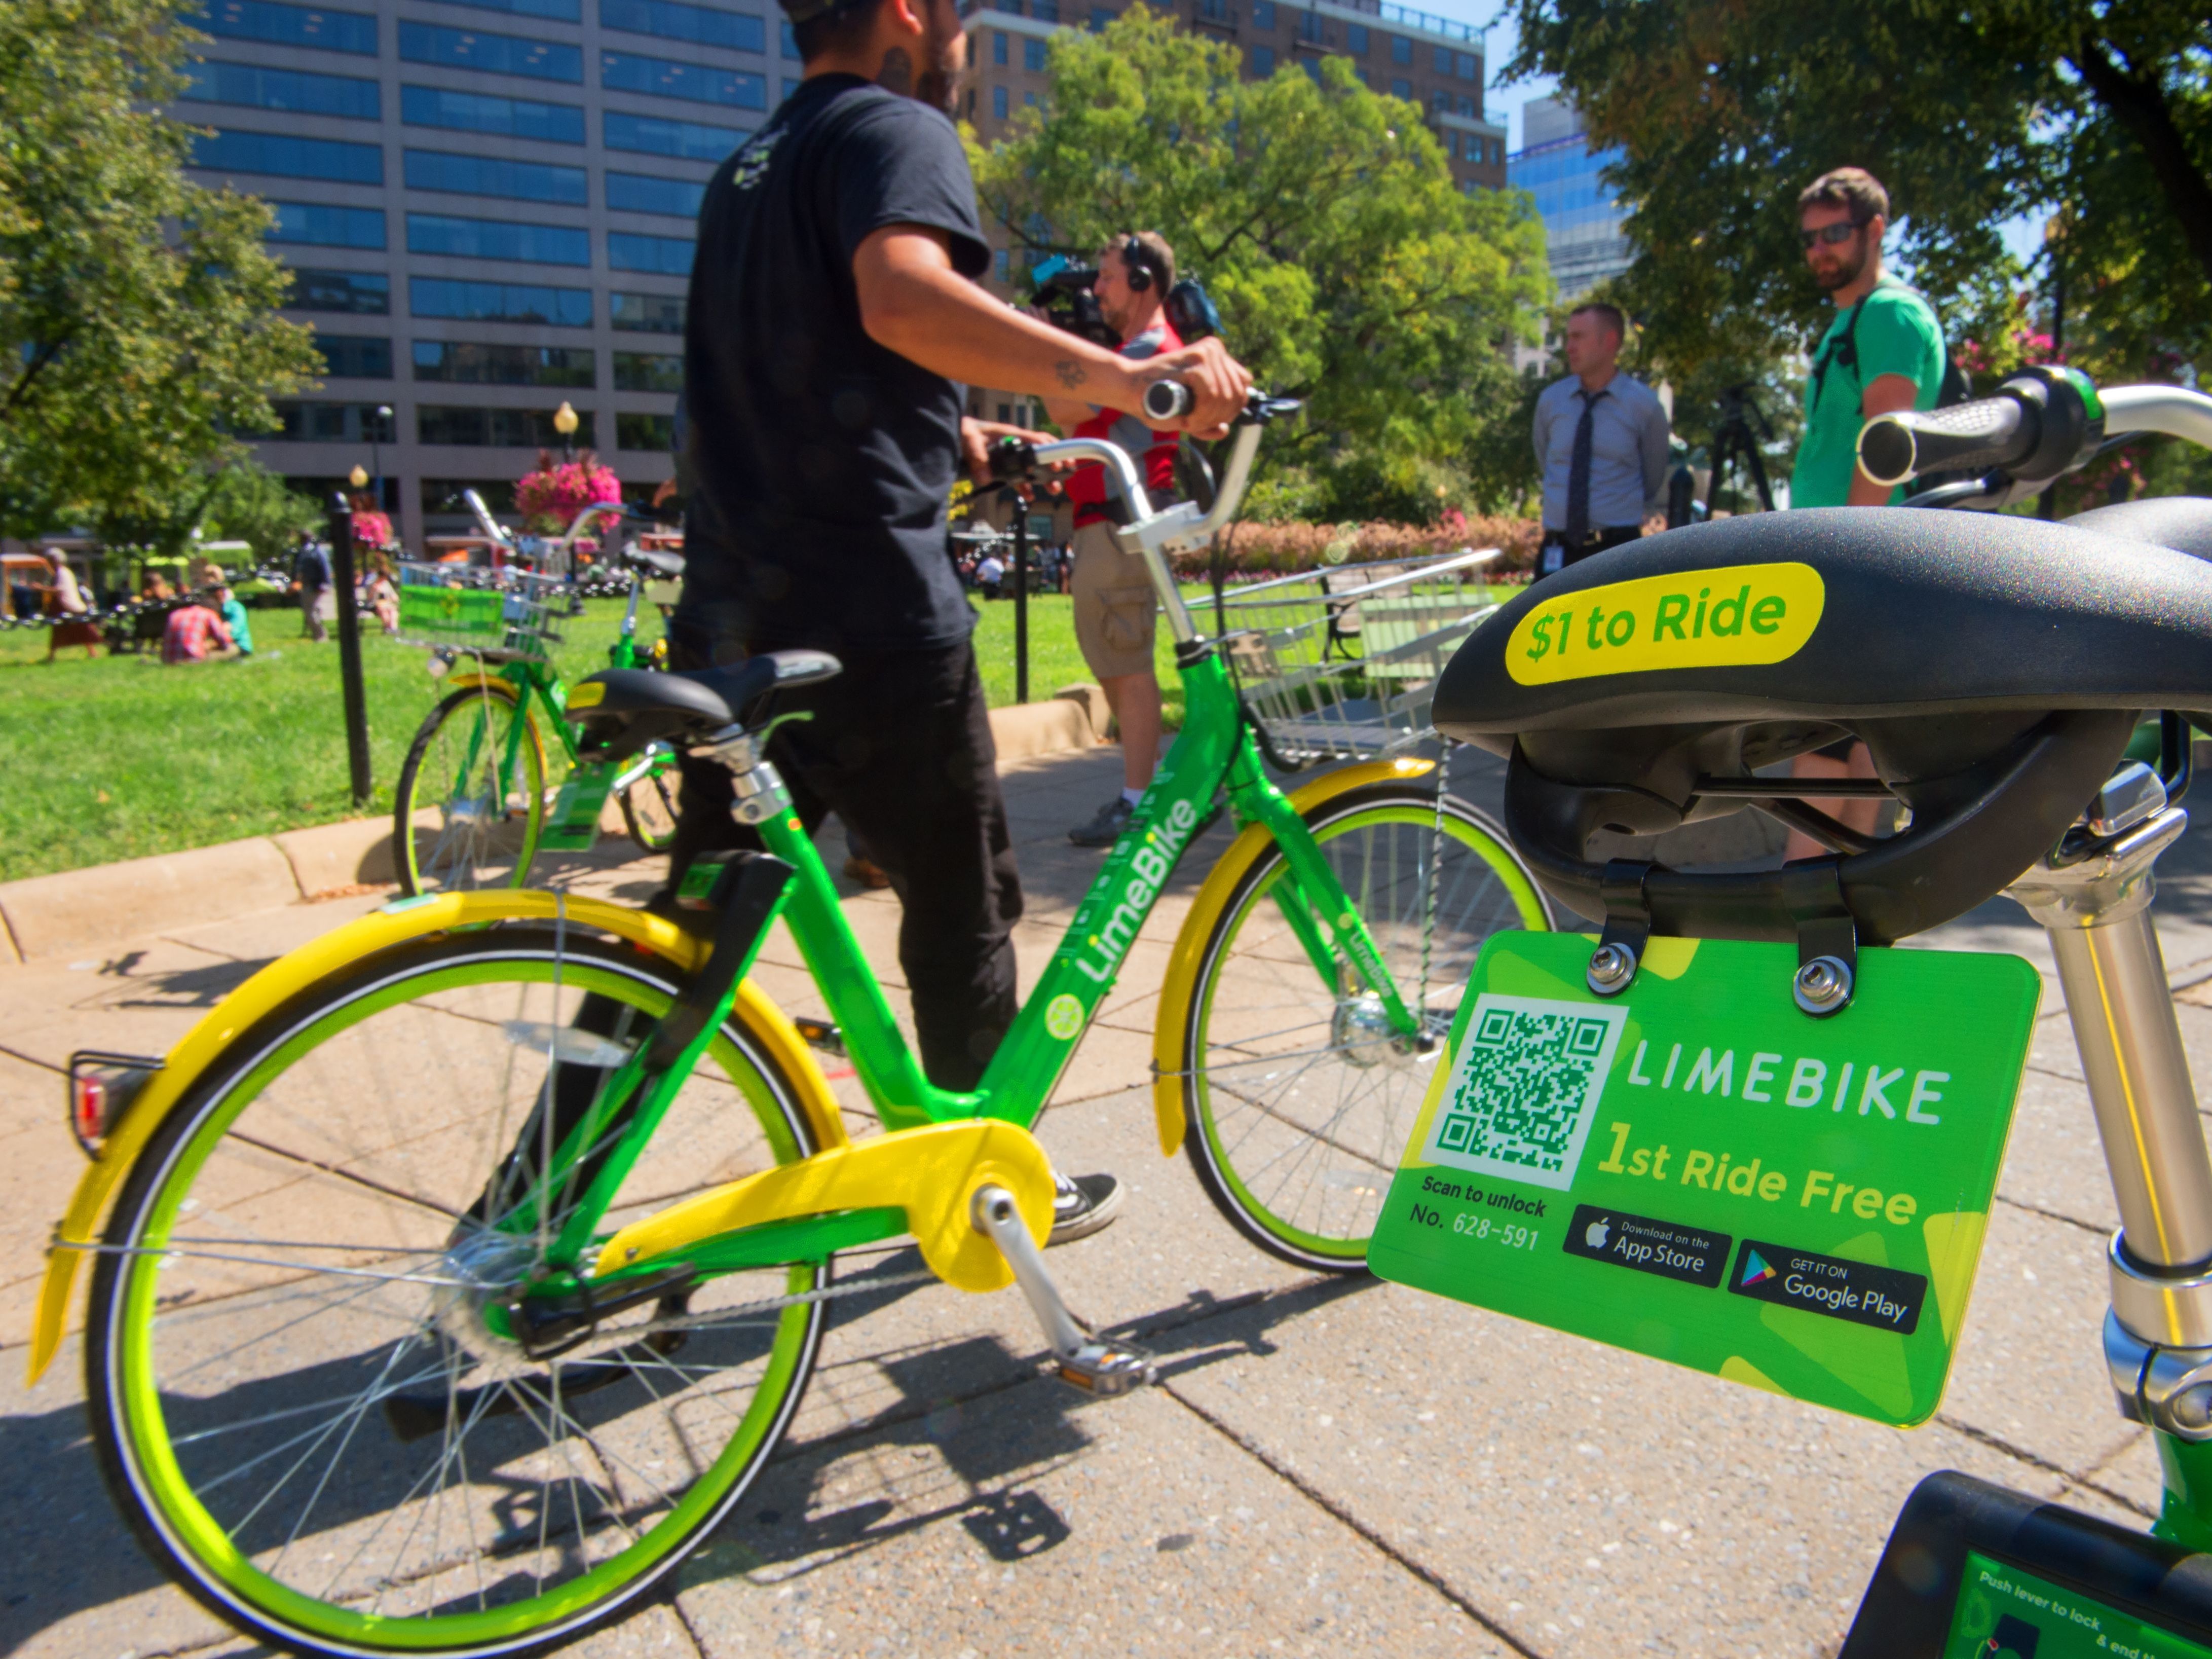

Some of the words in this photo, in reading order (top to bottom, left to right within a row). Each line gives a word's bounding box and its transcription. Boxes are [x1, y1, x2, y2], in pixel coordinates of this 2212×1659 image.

[1526, 612, 1573, 662] $1
[1587, 607, 1635, 650] to
[1653, 585, 1786, 643] Ride
[1075, 799, 1197, 982] LimeBike
[1627, 1040, 1951, 1125] LIMEBIKE
[1421, 1175, 1461, 1198] Scan
[1466, 1185, 1483, 1203] to
[1487, 1193, 1547, 1218] unlock
[1598, 1121, 1671, 1181] 1st
[1680, 1150, 1787, 1201] Ride
[1800, 1170, 1917, 1225] Free
[1409, 1203, 1444, 1229] No.
[1453, 1213, 1539, 1250] 628-591
[1622, 1222, 1673, 1241] Download
[1675, 1235, 1688, 1245] on
[1692, 1237, 1710, 1249] the
[1614, 1236, 1652, 1263] App
[1654, 1244, 1705, 1272] Store
[1791, 1258, 1814, 1273] GET
[1815, 1263, 1827, 1274] IT
[1828, 1266, 1848, 1280] ON
[1784, 1274, 1859, 1310] Google
[1862, 1291, 1908, 1324] Play
[1980, 1570, 2012, 1594] Push
[2014, 1584, 2050, 1608] lever
[2051, 1601, 2068, 1616] to
[2069, 1608, 2101, 1631] lock
[2096, 1633, 2108, 1648] &
[2110, 1640, 2141, 1659] end
